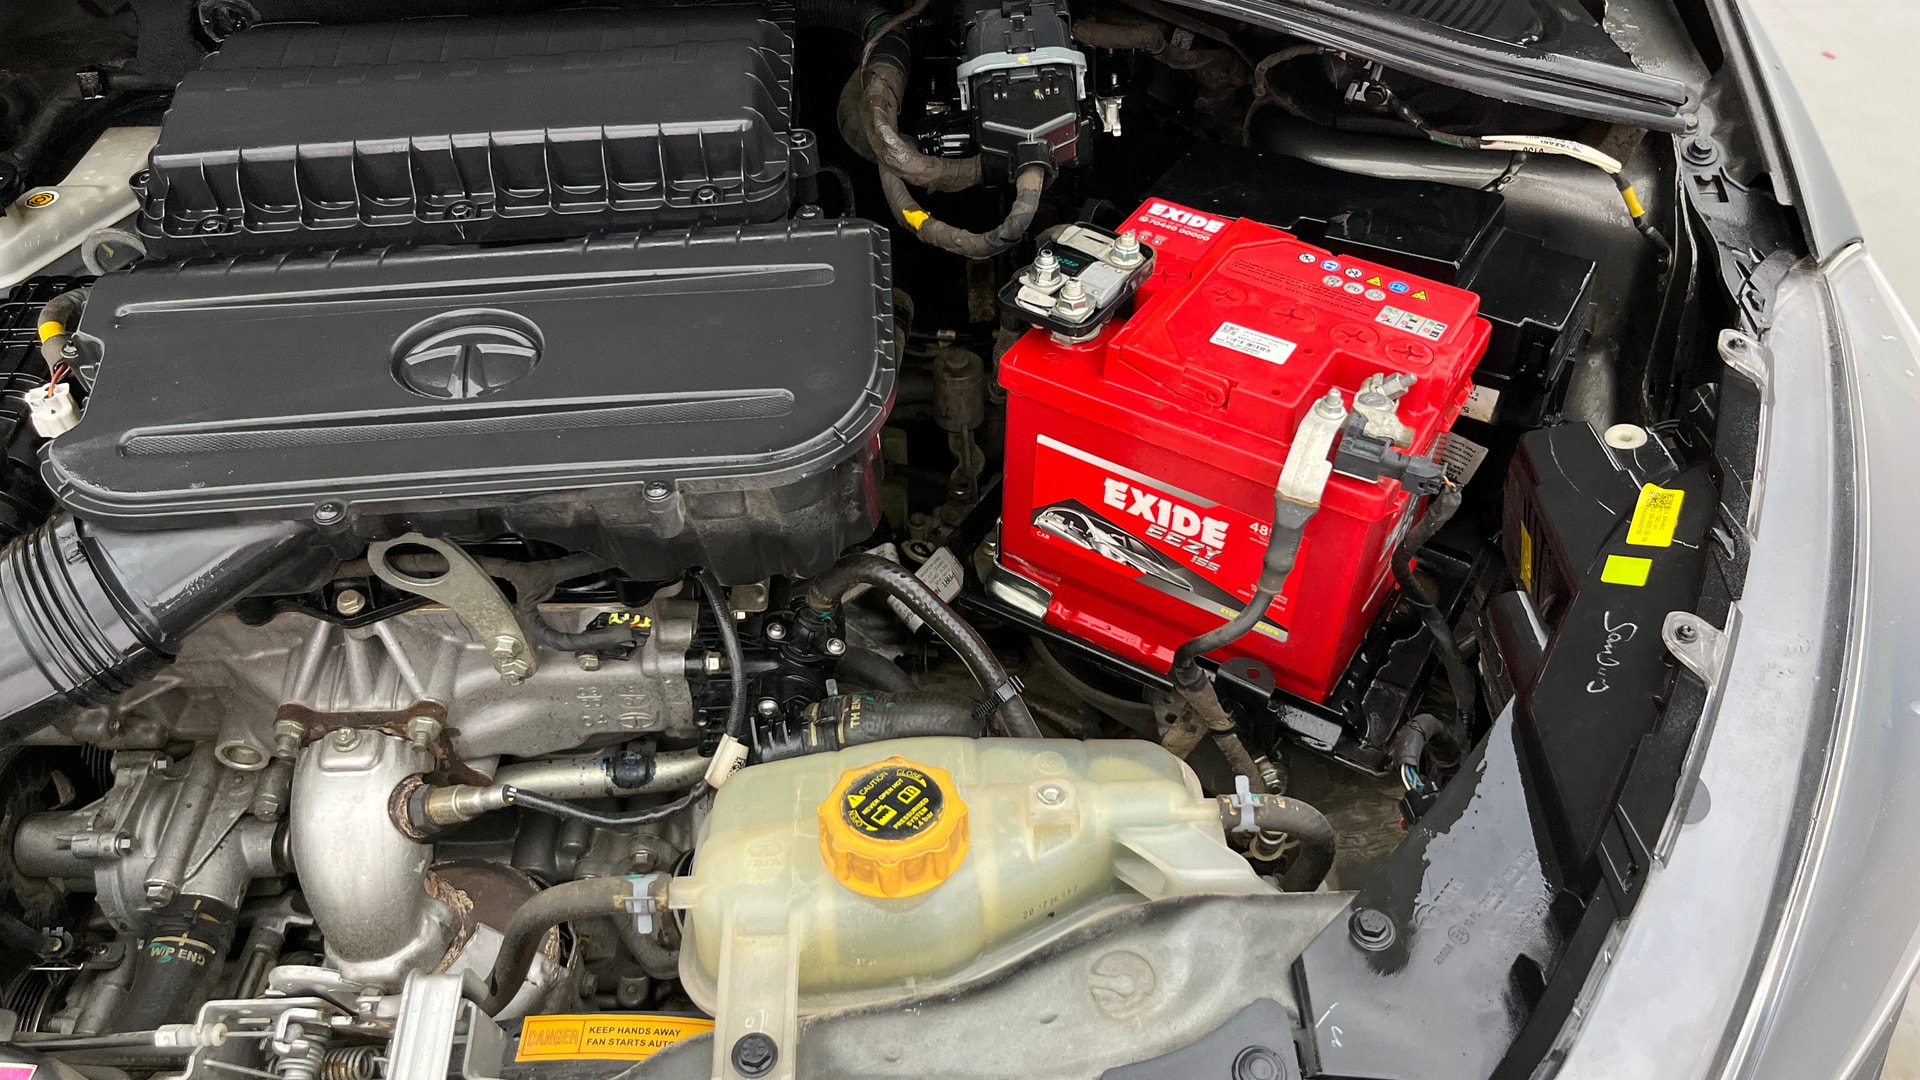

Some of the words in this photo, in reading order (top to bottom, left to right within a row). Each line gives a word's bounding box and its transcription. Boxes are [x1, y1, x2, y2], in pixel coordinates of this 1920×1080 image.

[1147, 203, 1226, 234] EXIDE
[1147, 218, 1178, 233] 70440
[1178, 228, 1210, 242] 00000
[1103, 477, 1230, 550] EXIDE
[1036, 530, 1051, 541] CAR
[1249, 521, 1272, 537] 48
[1145, 524, 1223, 560] EEZY
[858, 770, 889, 796] CAUTION
[896, 768, 923, 780] CLOSE
[861, 798, 880, 816] NEVER
[878, 787, 894, 801] OPEN
[892, 778, 905, 790] HOT
[848, 809, 863, 827] OPEN
[892, 797, 930, 830] PRESSURISED
[906, 806, 928, 827] SYSTEM
[923, 811, 935, 823] bar
[526, 1029, 580, 1047] DANGER
[589, 1026, 615, 1035] KEEP
[617, 1027, 651, 1036] HANDS
[653, 1028, 682, 1037] AWAY
[587, 1038, 605, 1047] FAN
[609, 1038, 647, 1048] STARTS
